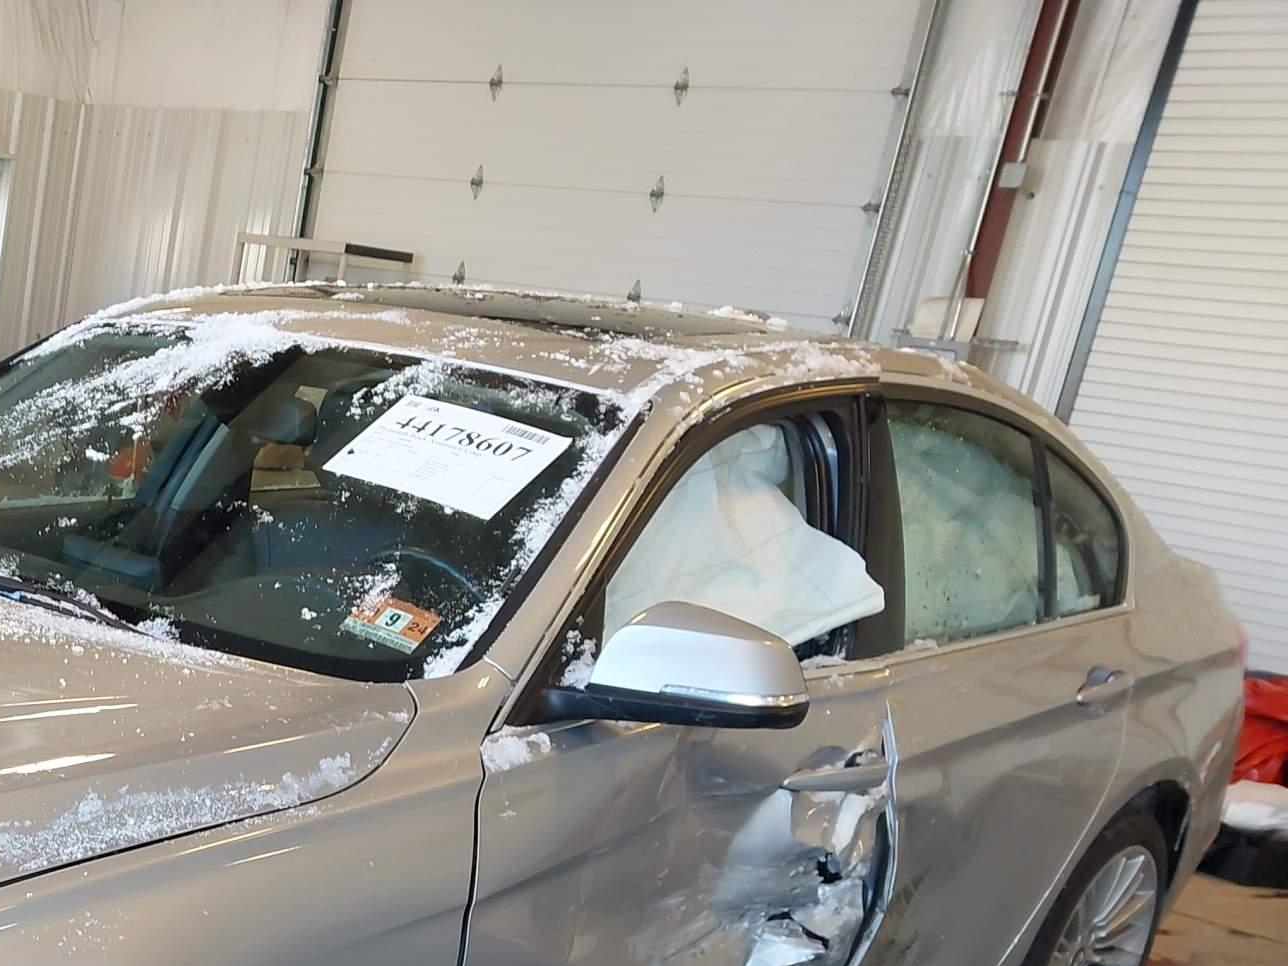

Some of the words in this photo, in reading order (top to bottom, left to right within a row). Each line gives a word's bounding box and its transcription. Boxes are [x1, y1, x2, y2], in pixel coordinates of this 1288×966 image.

[395, 416, 533, 461] 44178607
[385, 612, 402, 628] 9
[407, 622, 429, 635] 24
